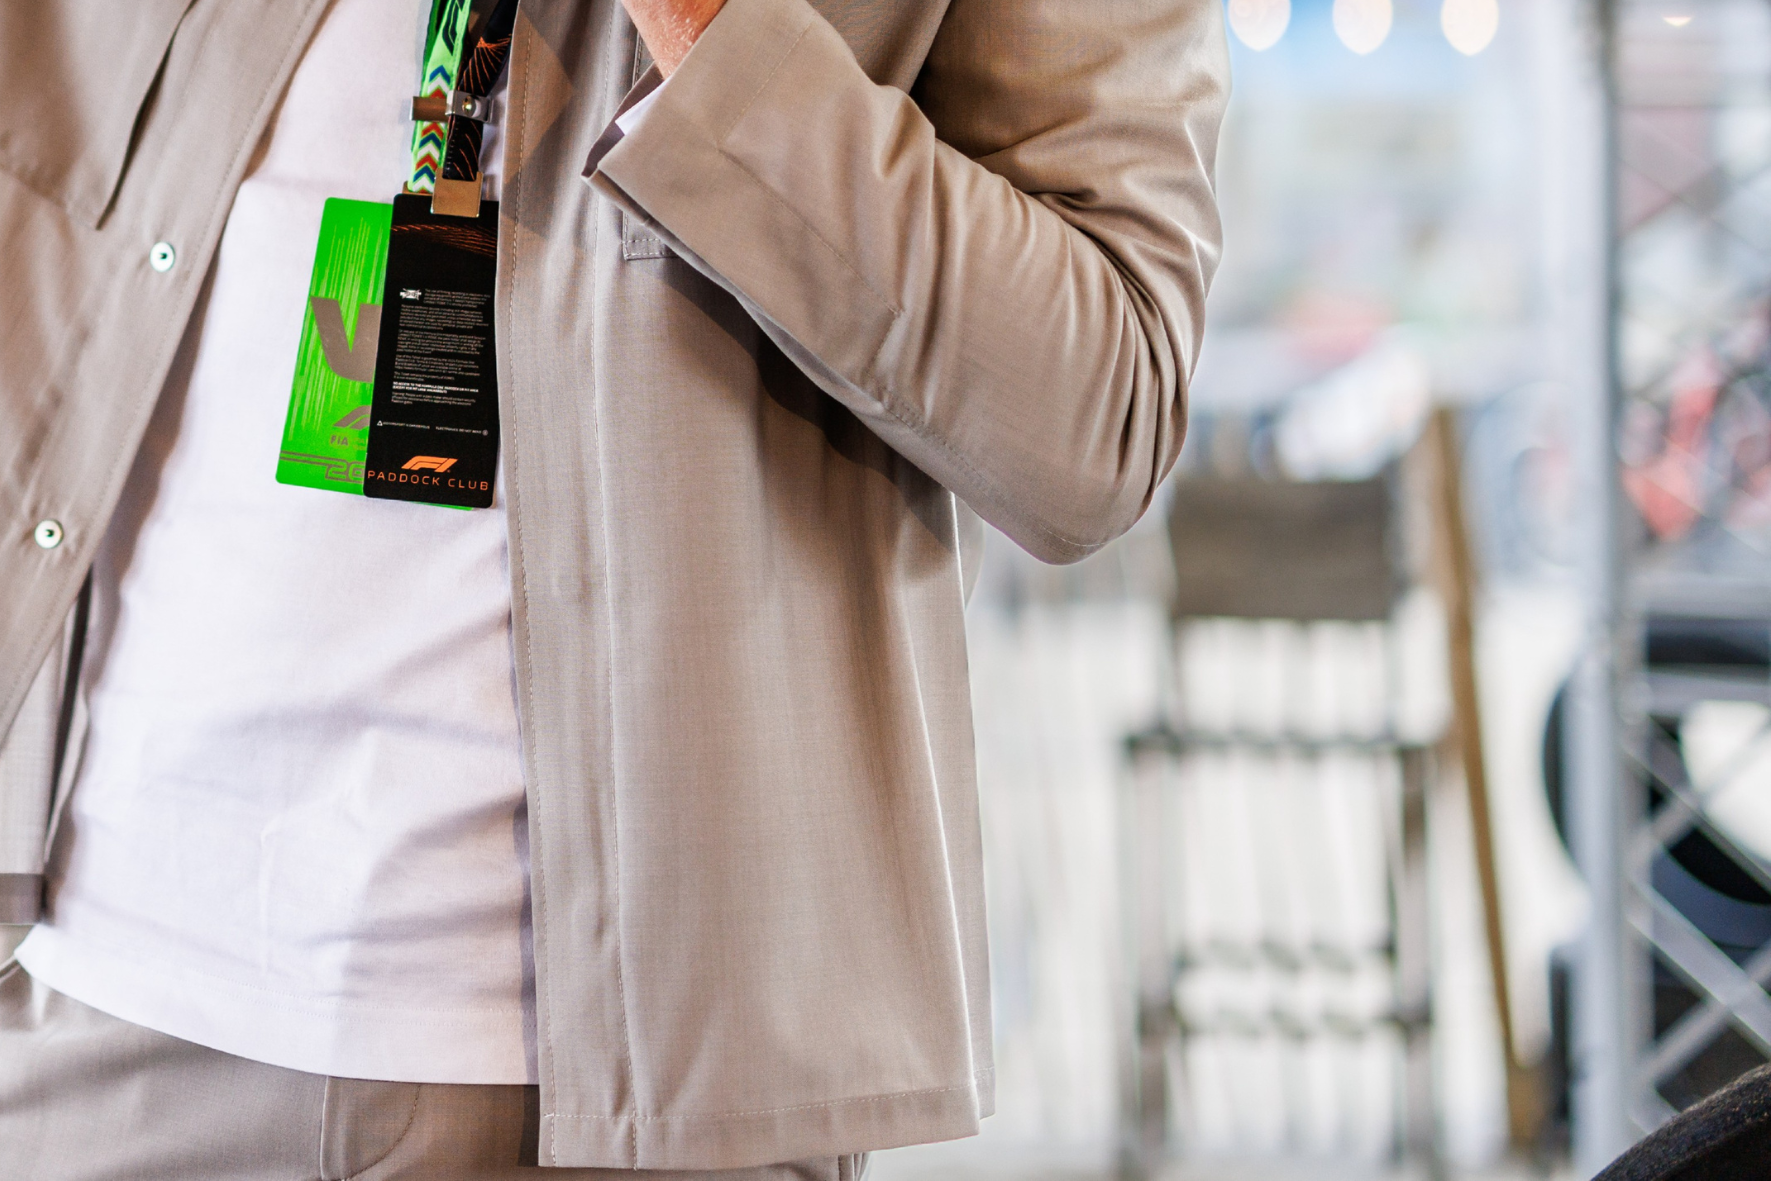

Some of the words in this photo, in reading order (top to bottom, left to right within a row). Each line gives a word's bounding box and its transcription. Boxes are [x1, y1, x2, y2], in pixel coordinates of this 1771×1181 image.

[330, 434, 349, 446] FIA
[367, 470, 441, 487] PADDOCK
[447, 478, 489, 491] CLUB
